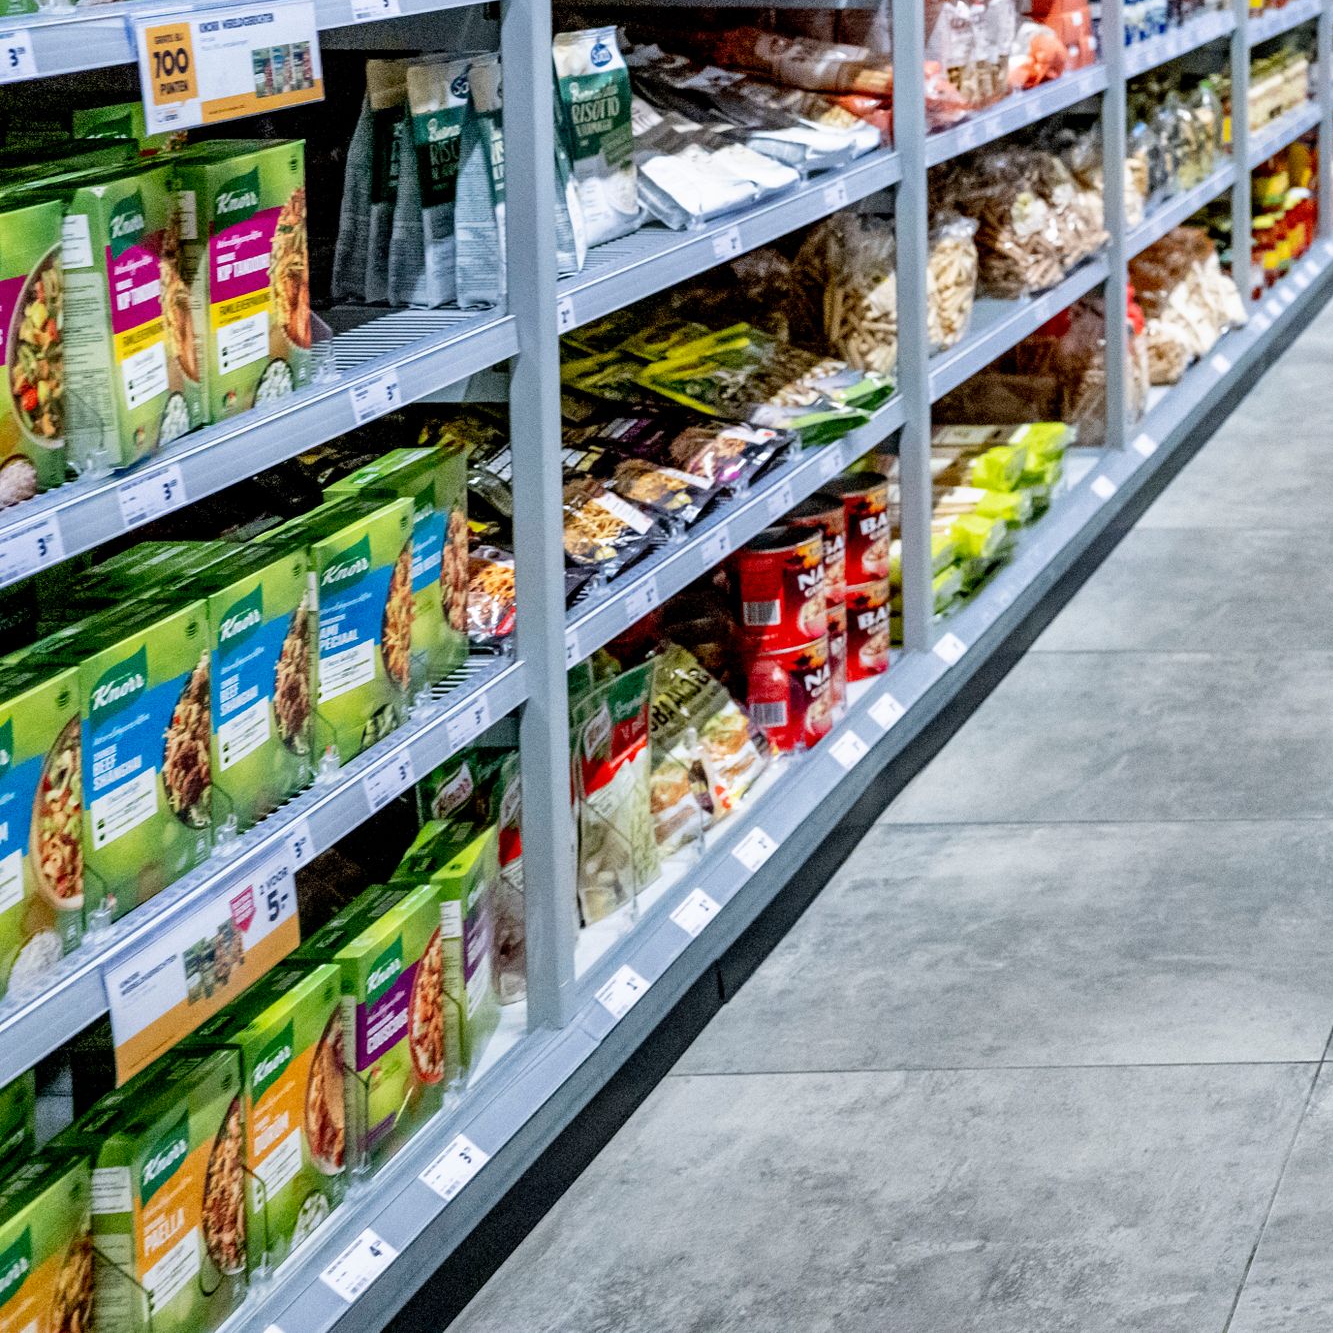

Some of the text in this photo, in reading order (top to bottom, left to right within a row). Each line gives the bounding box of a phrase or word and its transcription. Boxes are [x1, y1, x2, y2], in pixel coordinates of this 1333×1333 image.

[152, 47, 189, 79] 100
[160, 80, 189, 96] PUNTEN
[571, 99, 621, 128] RISOTTO
[217, 190, 259, 214] Knorr
[111, 211, 144, 238] Knorr
[320, 555, 370, 587] Knorr
[219, 609, 261, 642] Knorr
[90, 673, 146, 713] Knorr
[266, 866, 289, 890] VOOR
[366, 957, 402, 994] Knorr
[252, 1043, 293, 1086] Knorr
[142, 1140, 188, 1188] Knorr
